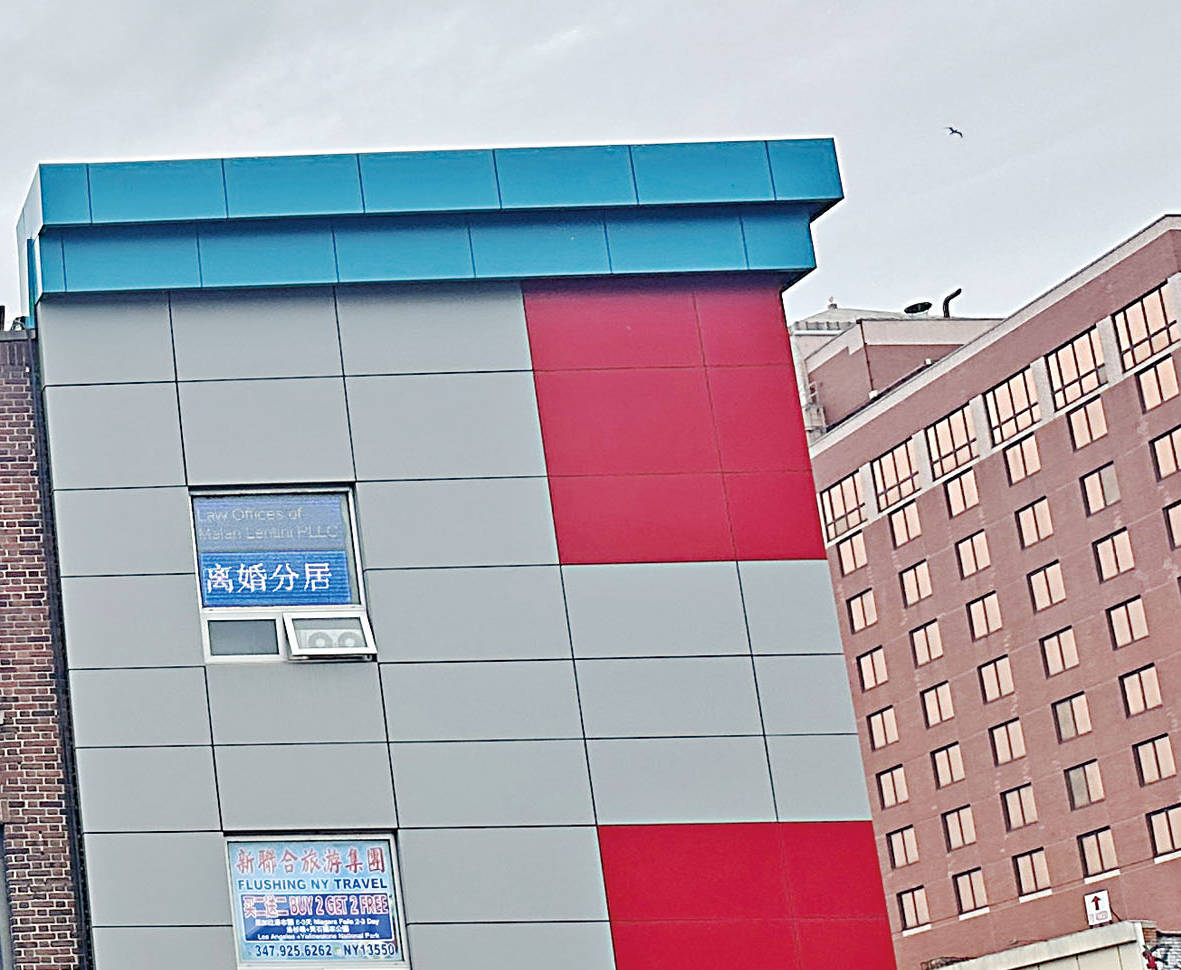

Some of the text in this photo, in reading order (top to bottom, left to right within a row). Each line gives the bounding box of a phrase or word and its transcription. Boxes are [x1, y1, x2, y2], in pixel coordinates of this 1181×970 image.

[206, 562, 332, 593] 离婚分居
[238, 877, 388, 890] FLUSHING NY TRAVEL
[289, 895, 314, 916] BUY
[315, 895, 324, 916] 2
[325, 894, 349, 915] GET
[350, 894, 359, 915] 2
[360, 894, 389, 915] FREE
[254, 943, 396, 957] 347.925.6262 NY13550
